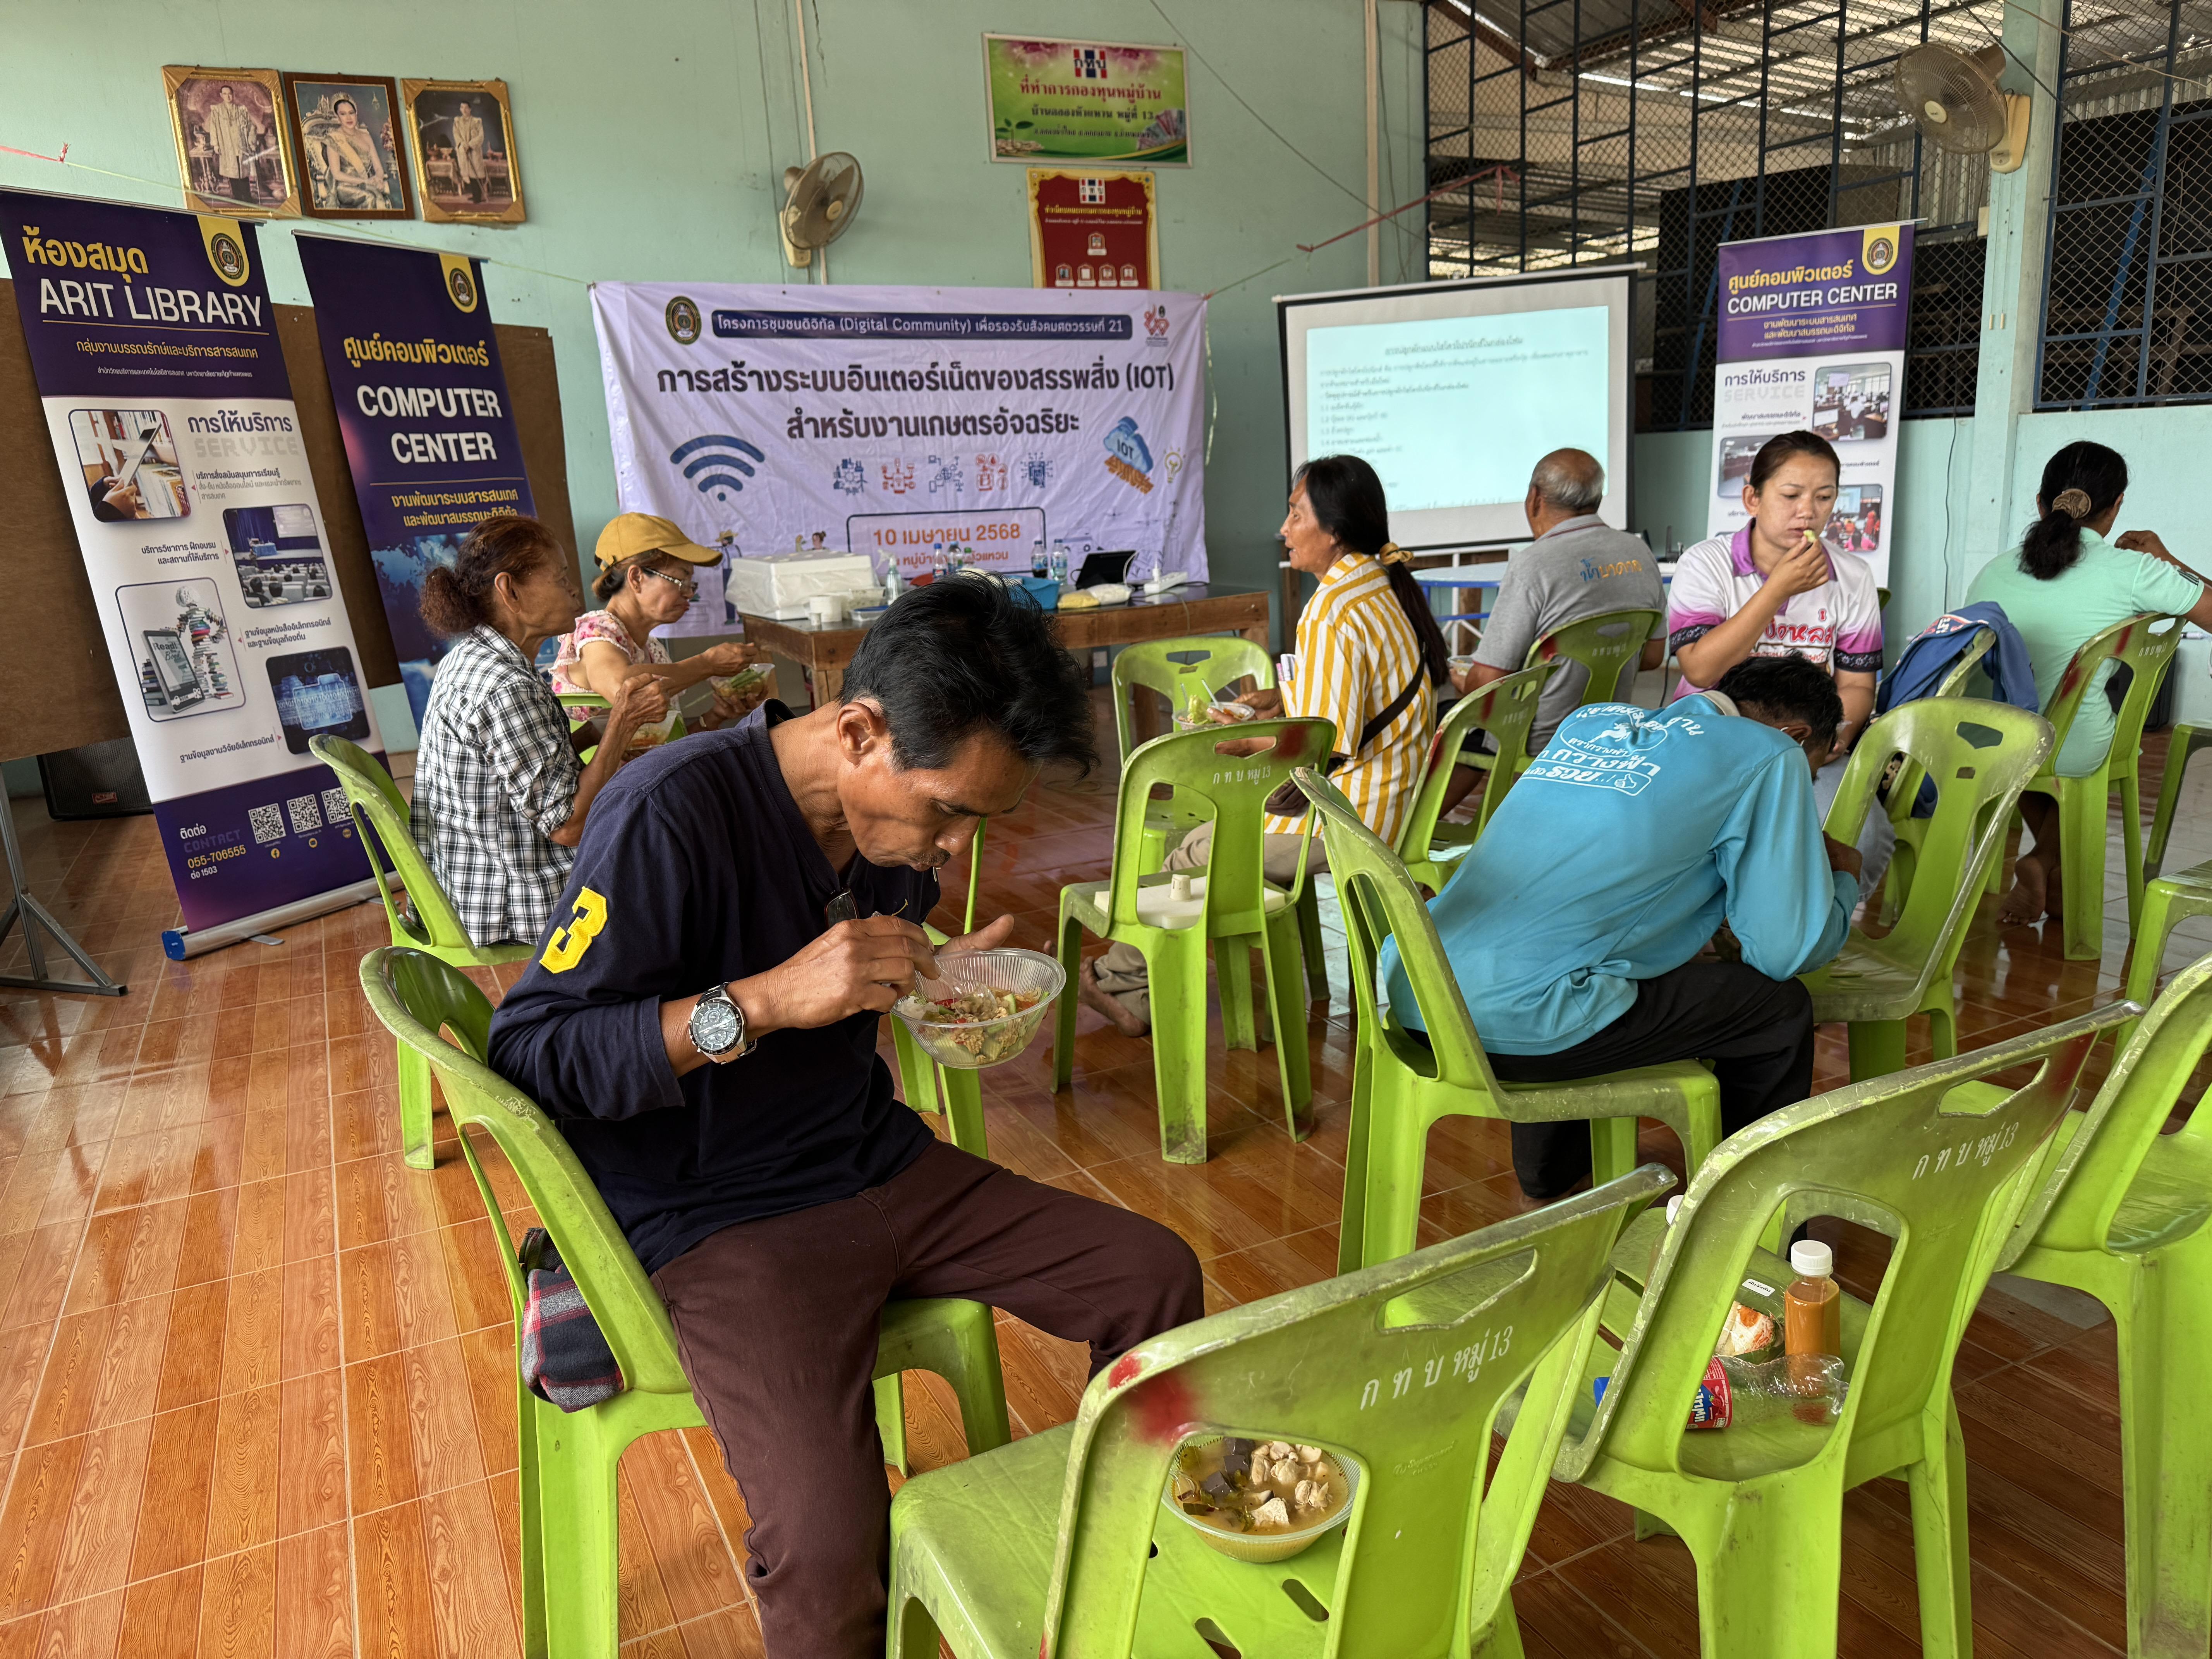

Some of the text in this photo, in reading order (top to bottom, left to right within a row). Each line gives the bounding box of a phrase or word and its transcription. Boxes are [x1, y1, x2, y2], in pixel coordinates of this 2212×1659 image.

[1020, 74, 1161, 104] ที่ทำการกองทุนหมู่บ้าน
[23, 225, 149, 283] ห้องสมุด
[1728, 259, 1854, 295] ศูนย์คอมพิวเตอร์
[40, 278, 261, 326] ARIT LIBRARY
[1728, 283, 1897, 314] COMPUTER CENTER
[718, 314, 1123, 334] โครงการชุมชนดิจิทัล (Digital Community) เพื่อรองรับสังคมศตวรรษที่ 21
[1764, 313, 1858, 329] งานพัฒนาระบบสารสนเทศ
[77, 338, 258, 359] กลุ่มงานบรรณรักษ์และบริการสารสนเทศ
[343, 332, 489, 368] ศูนย์คอมพิวเตอร์
[658, 355, 1174, 392] การสร้างระบบอินเตอร์เน็ตของสรรพสิ่ง (IOT)
[1725, 369, 1805, 386] การให้บริการ
[357, 385, 502, 418] COMPUTER
[1724, 385, 1805, 403] SERVICE
[188, 410, 292, 433] การให้บริการ
[787, 407, 1079, 439] สำหรับงานเกษตรอัจฉริยะ
[194, 436, 299, 458] SERVICE
[391, 432, 497, 463] CENTER
[1117, 439, 1133, 459] IOT
[391, 488, 519, 507] งานพัฒนาระบบสารสนเทศ
[874, 523, 1021, 546] 10 เมษายน 2568
[141, 541, 216, 554] บริการวิชาการ ฝึกอบรม
[158, 551, 219, 565] และสถานที่ให้บริการ
[1551, 749, 1661, 776] กวางฟ้า
[180, 823, 207, 840] ติดต่อ
[184, 829, 241, 853] CONTACT
[188, 844, 246, 869] 055-706555
[190, 865, 218, 879] ต่อ 1503
[539, 886, 607, 974] 3
